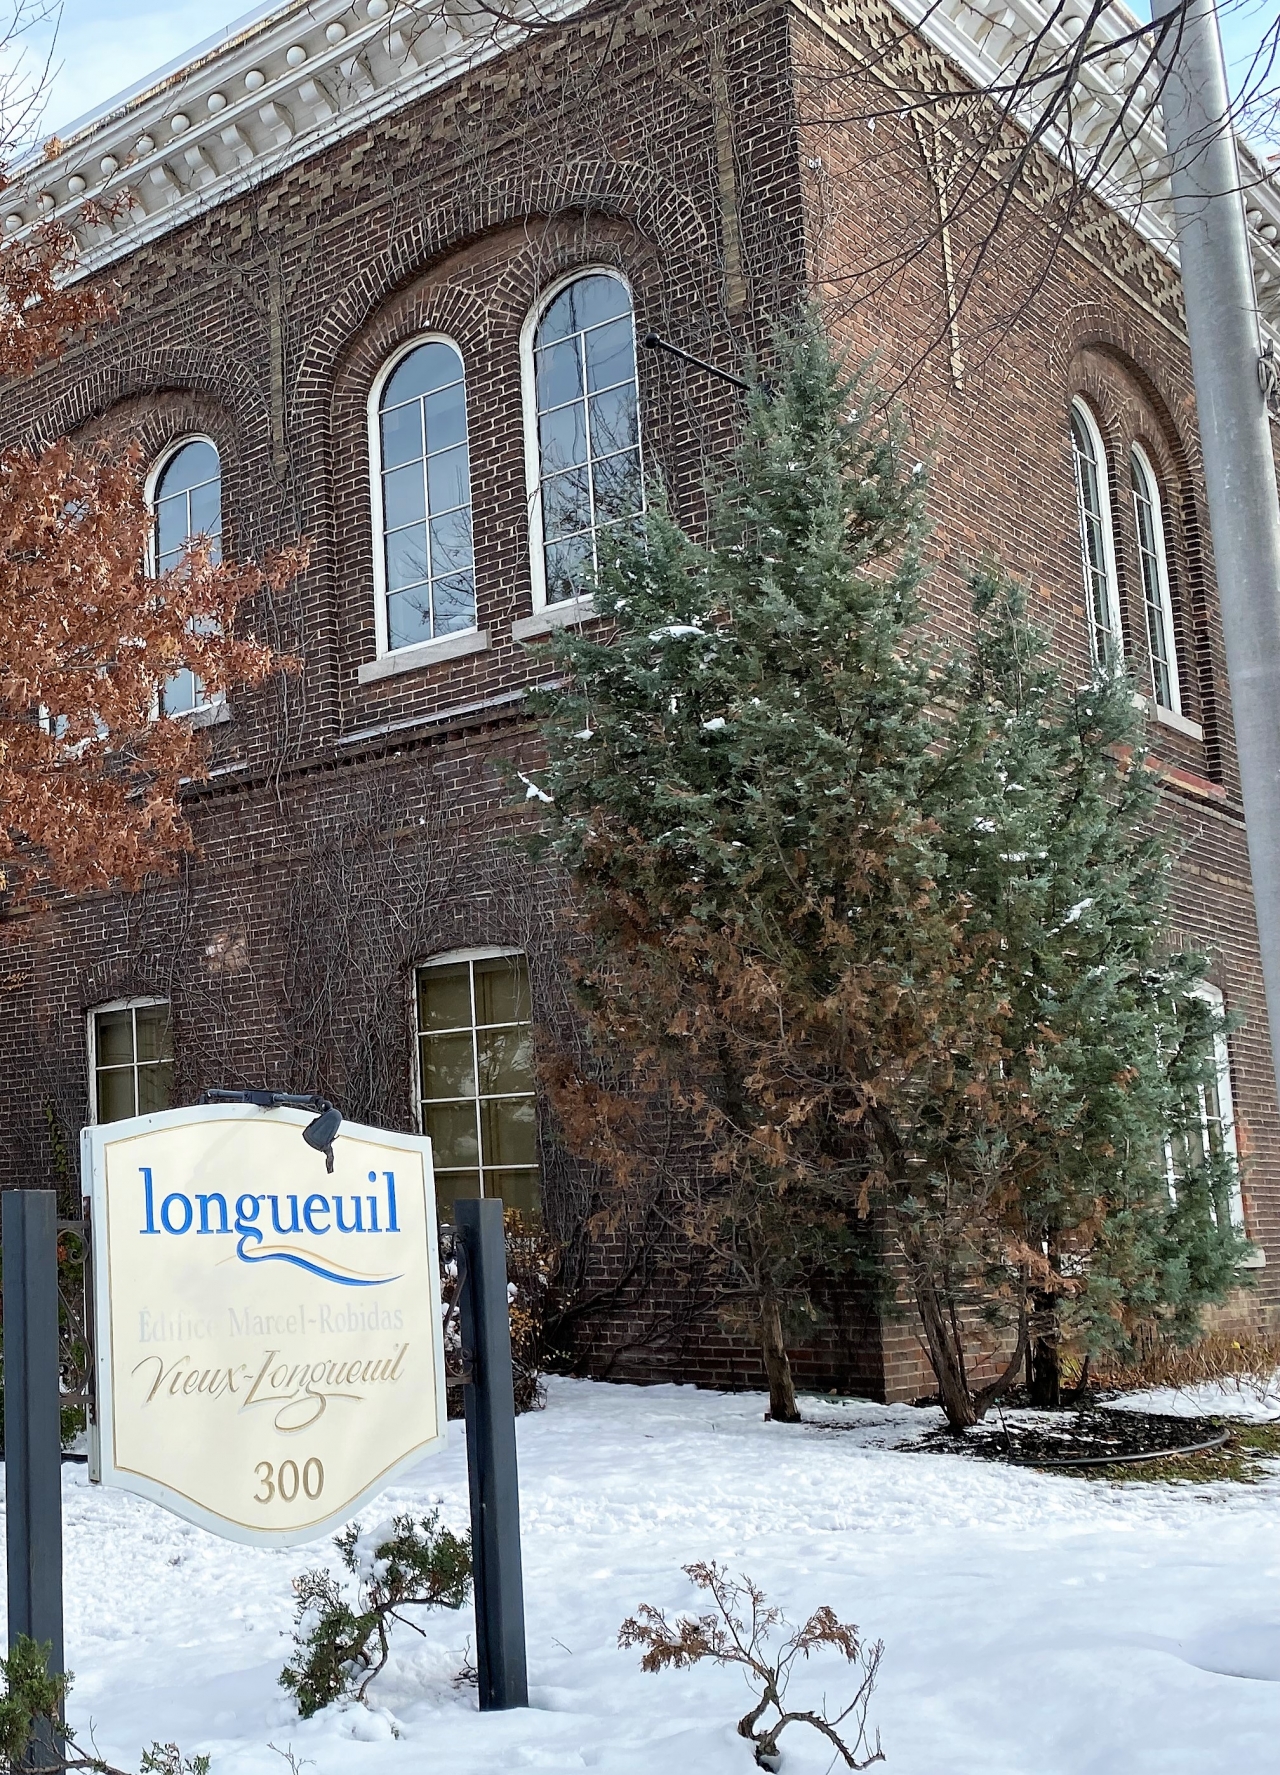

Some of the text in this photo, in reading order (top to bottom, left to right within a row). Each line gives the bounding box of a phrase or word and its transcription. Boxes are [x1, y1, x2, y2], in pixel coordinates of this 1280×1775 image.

[138, 1168, 402, 1262] longueuil
[139, 1301, 404, 1342] Édifice Marcel-Robidas
[132, 1343, 410, 1433] Vieux-Longueuil
[253, 1457, 324, 1504] 300
